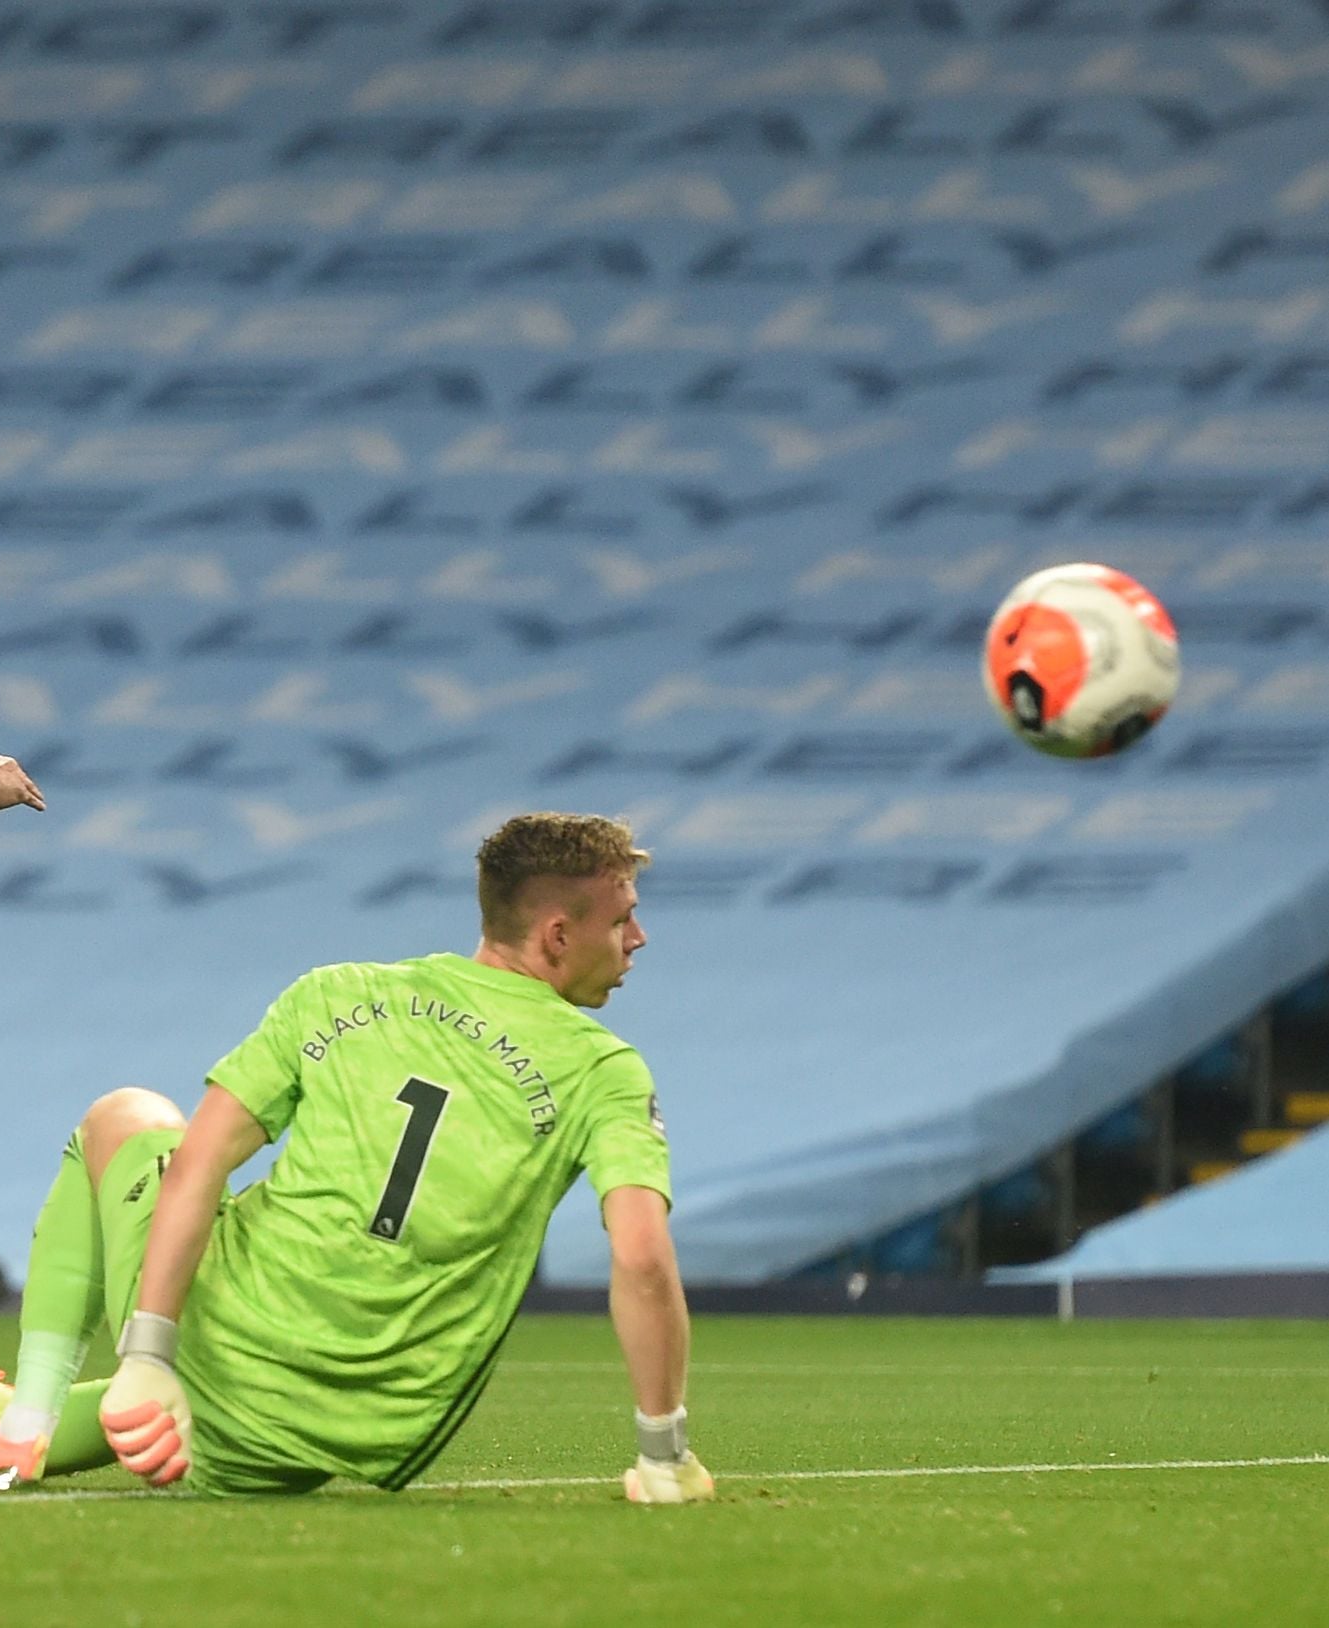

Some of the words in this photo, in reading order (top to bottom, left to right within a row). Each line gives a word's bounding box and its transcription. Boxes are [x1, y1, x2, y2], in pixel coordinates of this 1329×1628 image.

[302, 1001, 390, 1063] BLACK
[410, 995, 488, 1041] LIVES
[487, 1034, 558, 1139] MATTER
[369, 1076, 450, 1244] 1
